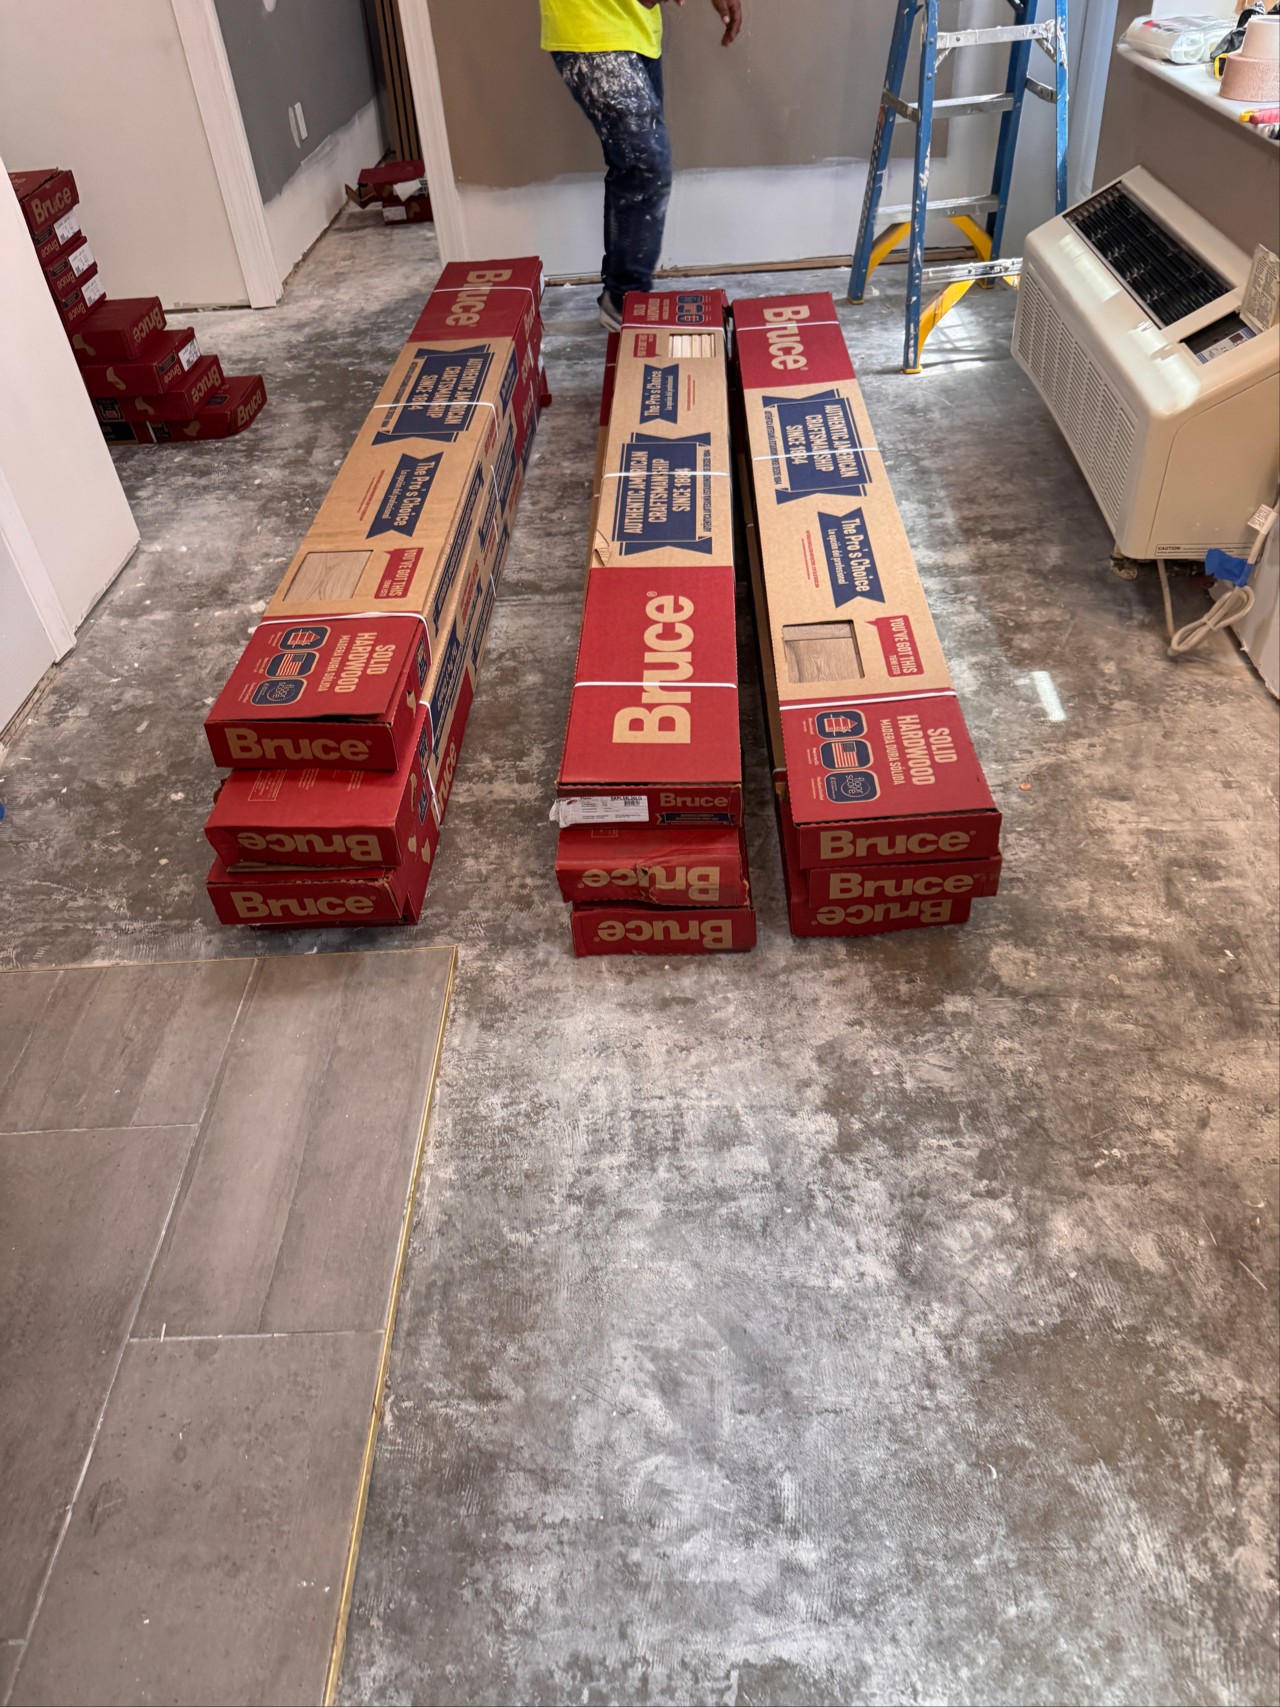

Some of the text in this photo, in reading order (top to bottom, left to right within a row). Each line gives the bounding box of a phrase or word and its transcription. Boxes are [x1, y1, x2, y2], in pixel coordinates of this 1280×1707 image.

[31, 186, 72, 225] Bruce
[446, 269, 513, 327] Bruce
[133, 306, 164, 343] Bruce
[762, 305, 810, 370] Bruce
[191, 365, 222, 403] Bruce
[415, 374, 438, 393] SINCE
[426, 366, 462, 418] CRAFTSMANHIP
[444, 358, 484, 424] AUTHENTIC AMRICAN
[237, 392, 263, 427] Bruce
[824, 405, 849, 440] AUTHENTIC
[786, 425, 806, 445] SINCE
[394, 461, 435, 526] The Pro's Choice
[623, 451, 648, 534] AUTHENTIC AMRICAN
[672, 488, 691, 512] SINCE
[841, 518, 874, 592] The Pro's Choice
[389, 581, 406, 597] THIS
[334, 632, 377, 693] HARDWOOD
[366, 644, 396, 675] SOLID
[889, 617, 918, 674] YOU'VE GOT THIS
[326, 657, 342, 673] DURA
[612, 595, 694, 744] Bruce
[224, 727, 370, 761] Bruce
[880, 718, 906, 786] MADERA DURA SÓLIDA
[897, 714, 936, 786] HARDWOOD
[927, 727, 958, 763] SOLID
[660, 792, 729, 807] Bruce
[845, 774, 857, 794] score
[237, 831, 383, 862] Bruce
[820, 829, 971, 860] Bruce
[582, 866, 720, 902] Bruce
[829, 872, 974, 899] Bruce
[230, 891, 375, 918] Bruce
[816, 899, 953, 925] Bruce
[598, 919, 733, 949] Bruce
